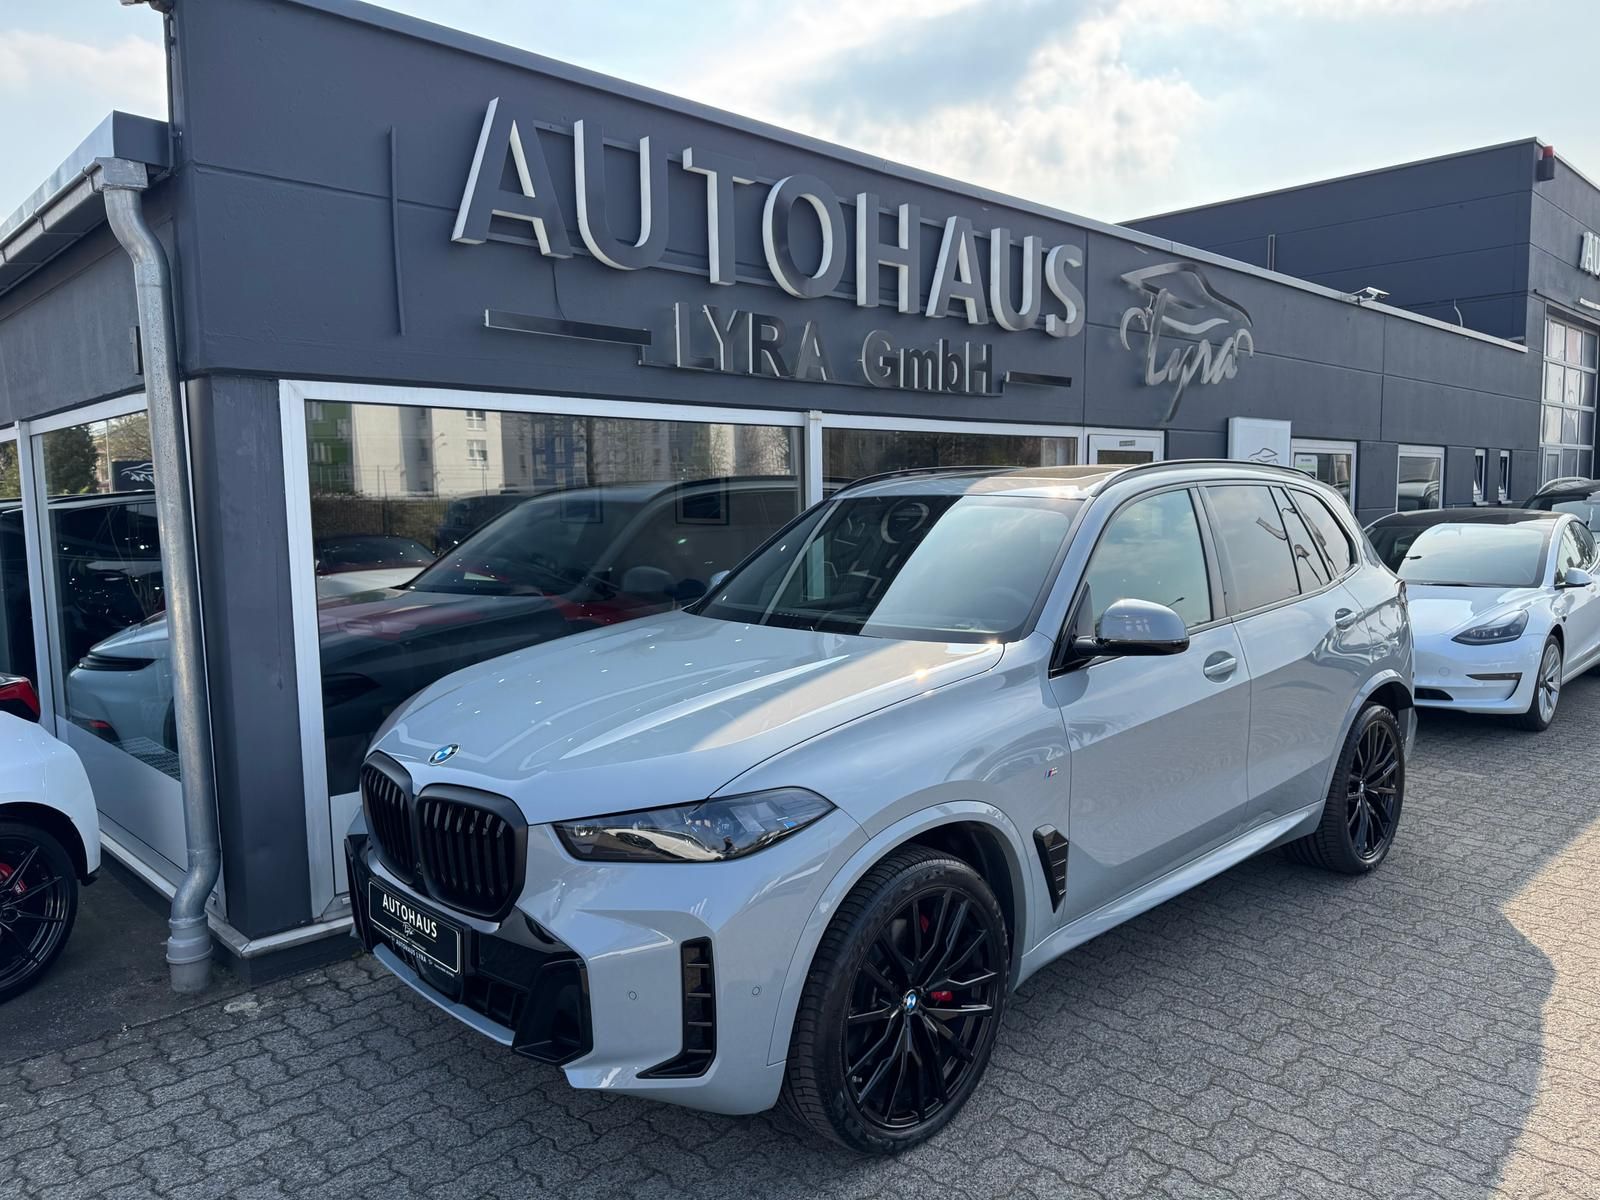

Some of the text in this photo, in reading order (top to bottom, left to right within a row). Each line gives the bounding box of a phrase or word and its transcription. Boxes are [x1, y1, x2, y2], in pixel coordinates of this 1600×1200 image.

[451, 96, 1085, 338] AUTOHAUS
[673, 302, 993, 394] LYRA GmbH
[382, 893, 438, 938] AUTOHAUS
